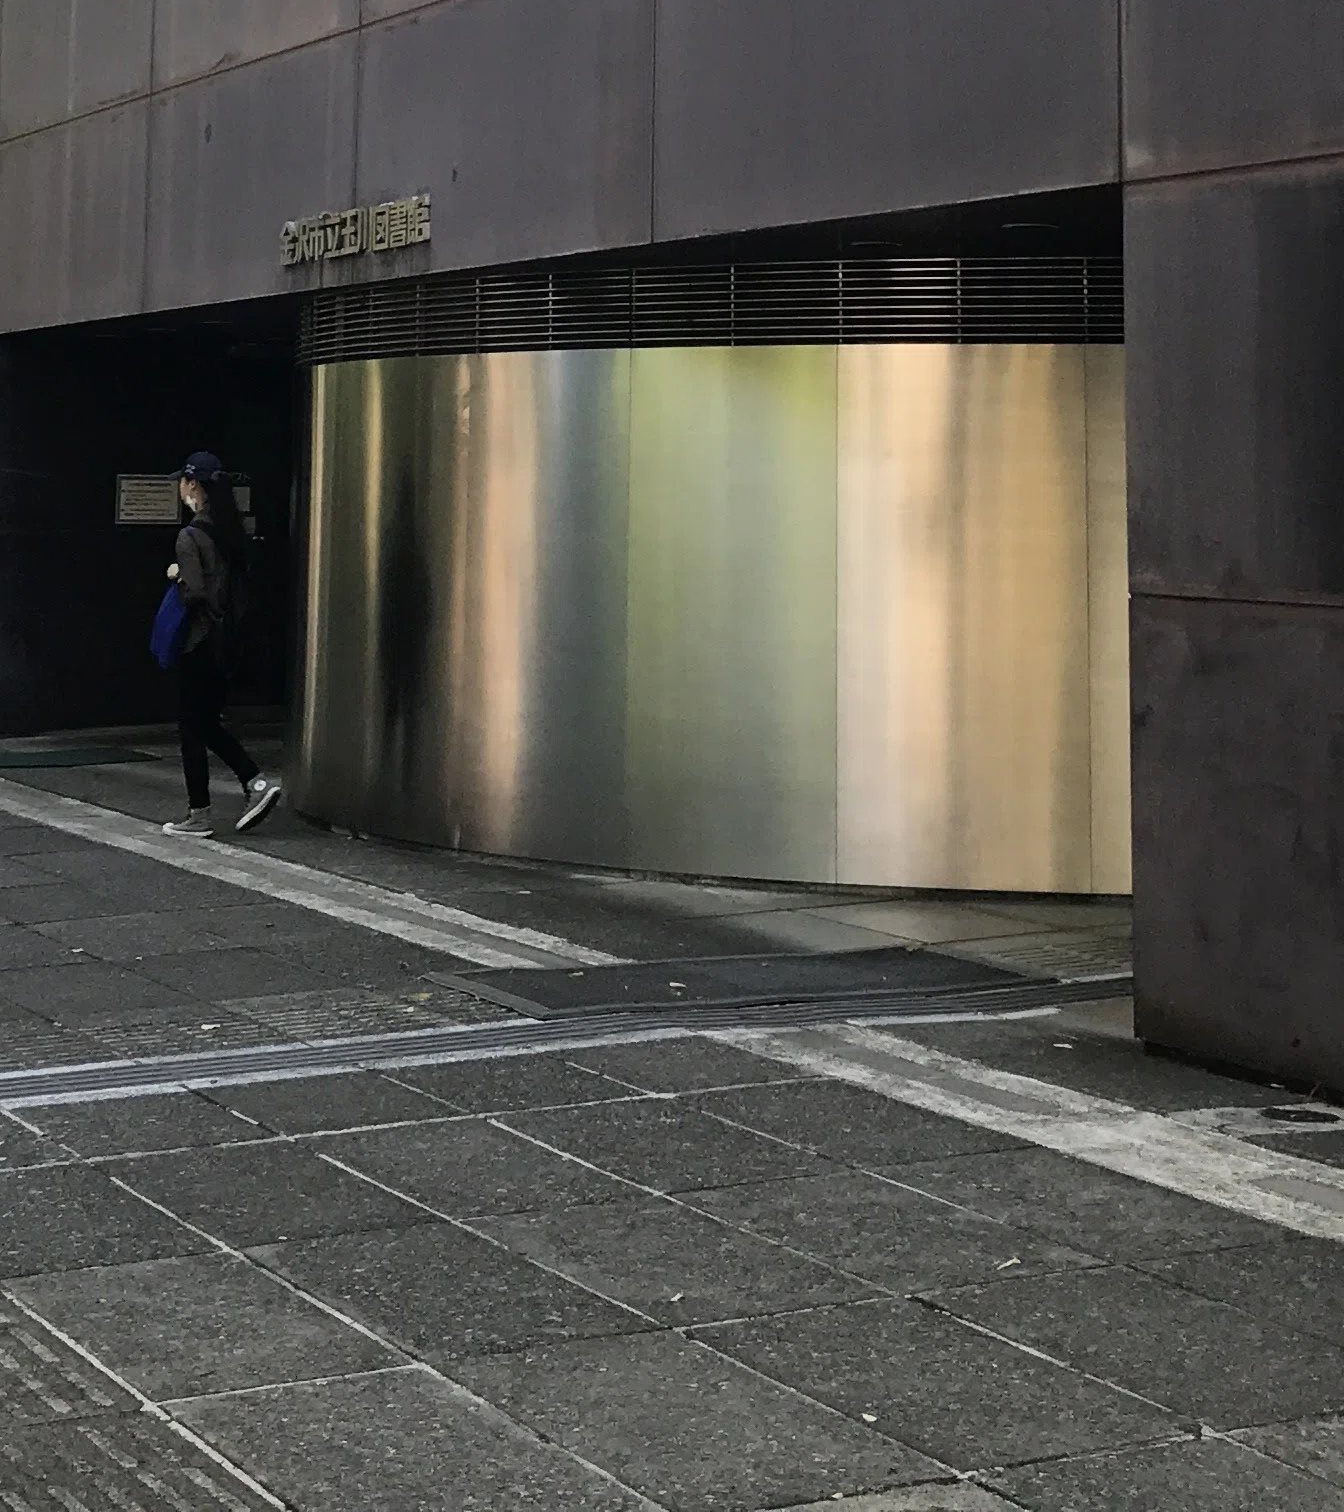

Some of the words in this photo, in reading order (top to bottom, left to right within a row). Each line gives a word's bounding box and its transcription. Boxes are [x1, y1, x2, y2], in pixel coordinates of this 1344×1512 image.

[279, 193, 431, 266] 金沢市立玉川図書館
